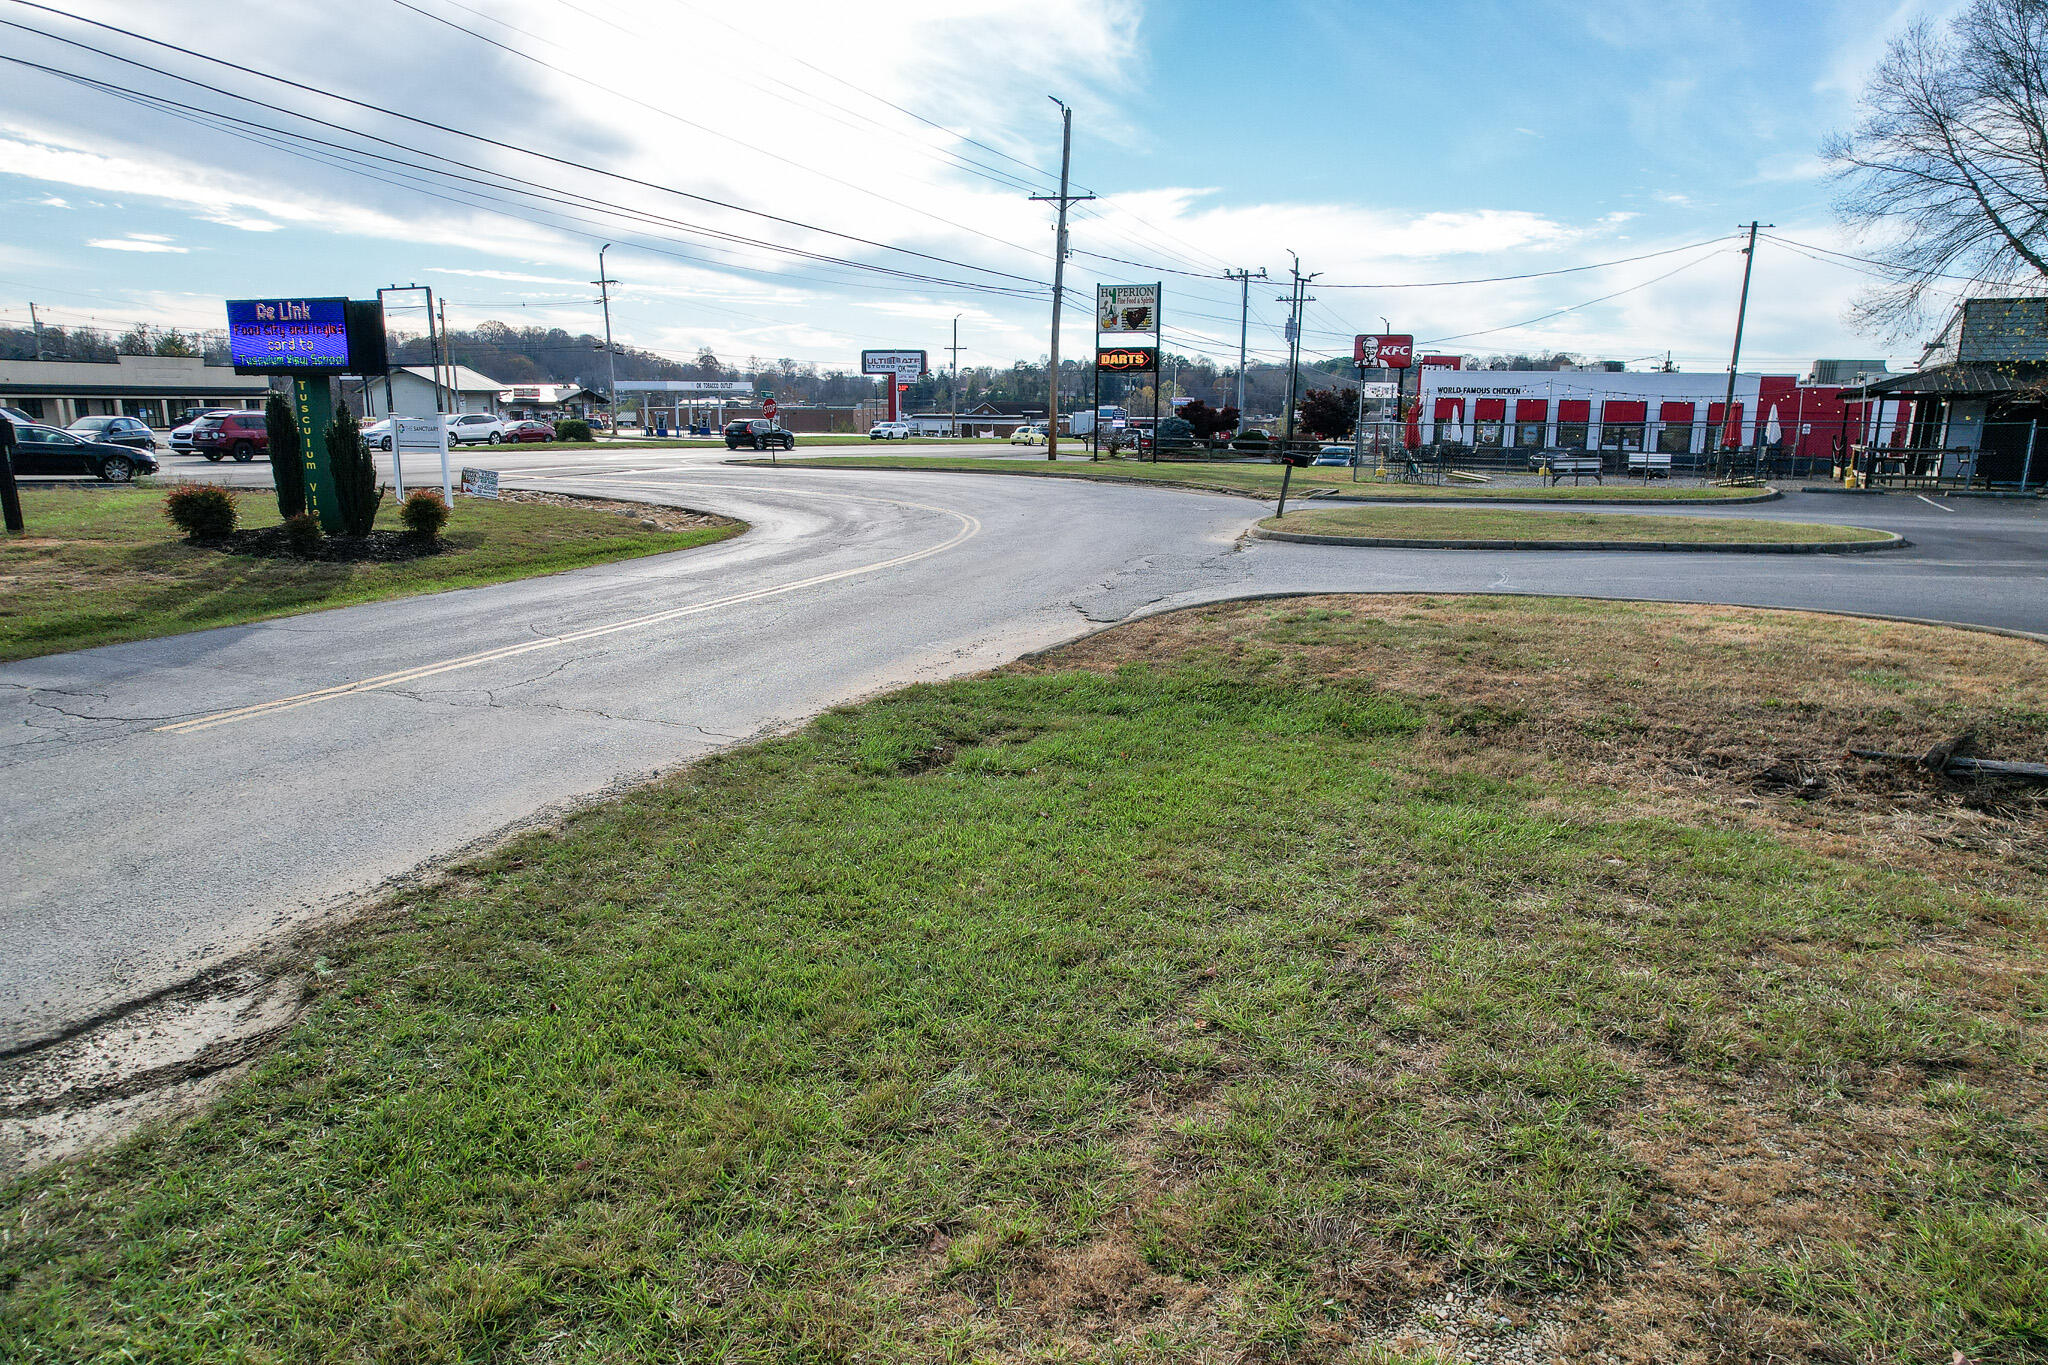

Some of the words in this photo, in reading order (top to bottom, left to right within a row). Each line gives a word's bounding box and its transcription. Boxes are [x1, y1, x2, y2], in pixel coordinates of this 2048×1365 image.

[1141, 297, 1154, 305] Spirits
[279, 301, 312, 320] Link
[234, 324, 260, 335] Food
[264, 324, 285, 338] City
[290, 324, 309, 335] and
[267, 338, 296, 351] card
[299, 338, 314, 351] to
[1380, 346, 1410, 356] KFC
[239, 354, 285, 366] Tusculum
[310, 353, 345, 365] School
[1101, 354, 1144, 365] DARTS
[1492, 387, 1521, 395] CHICKEN
[763, 403, 776, 415] STOP
[298, 380, 317, 470] Tusculum
[309, 482, 320, 517] Vie
